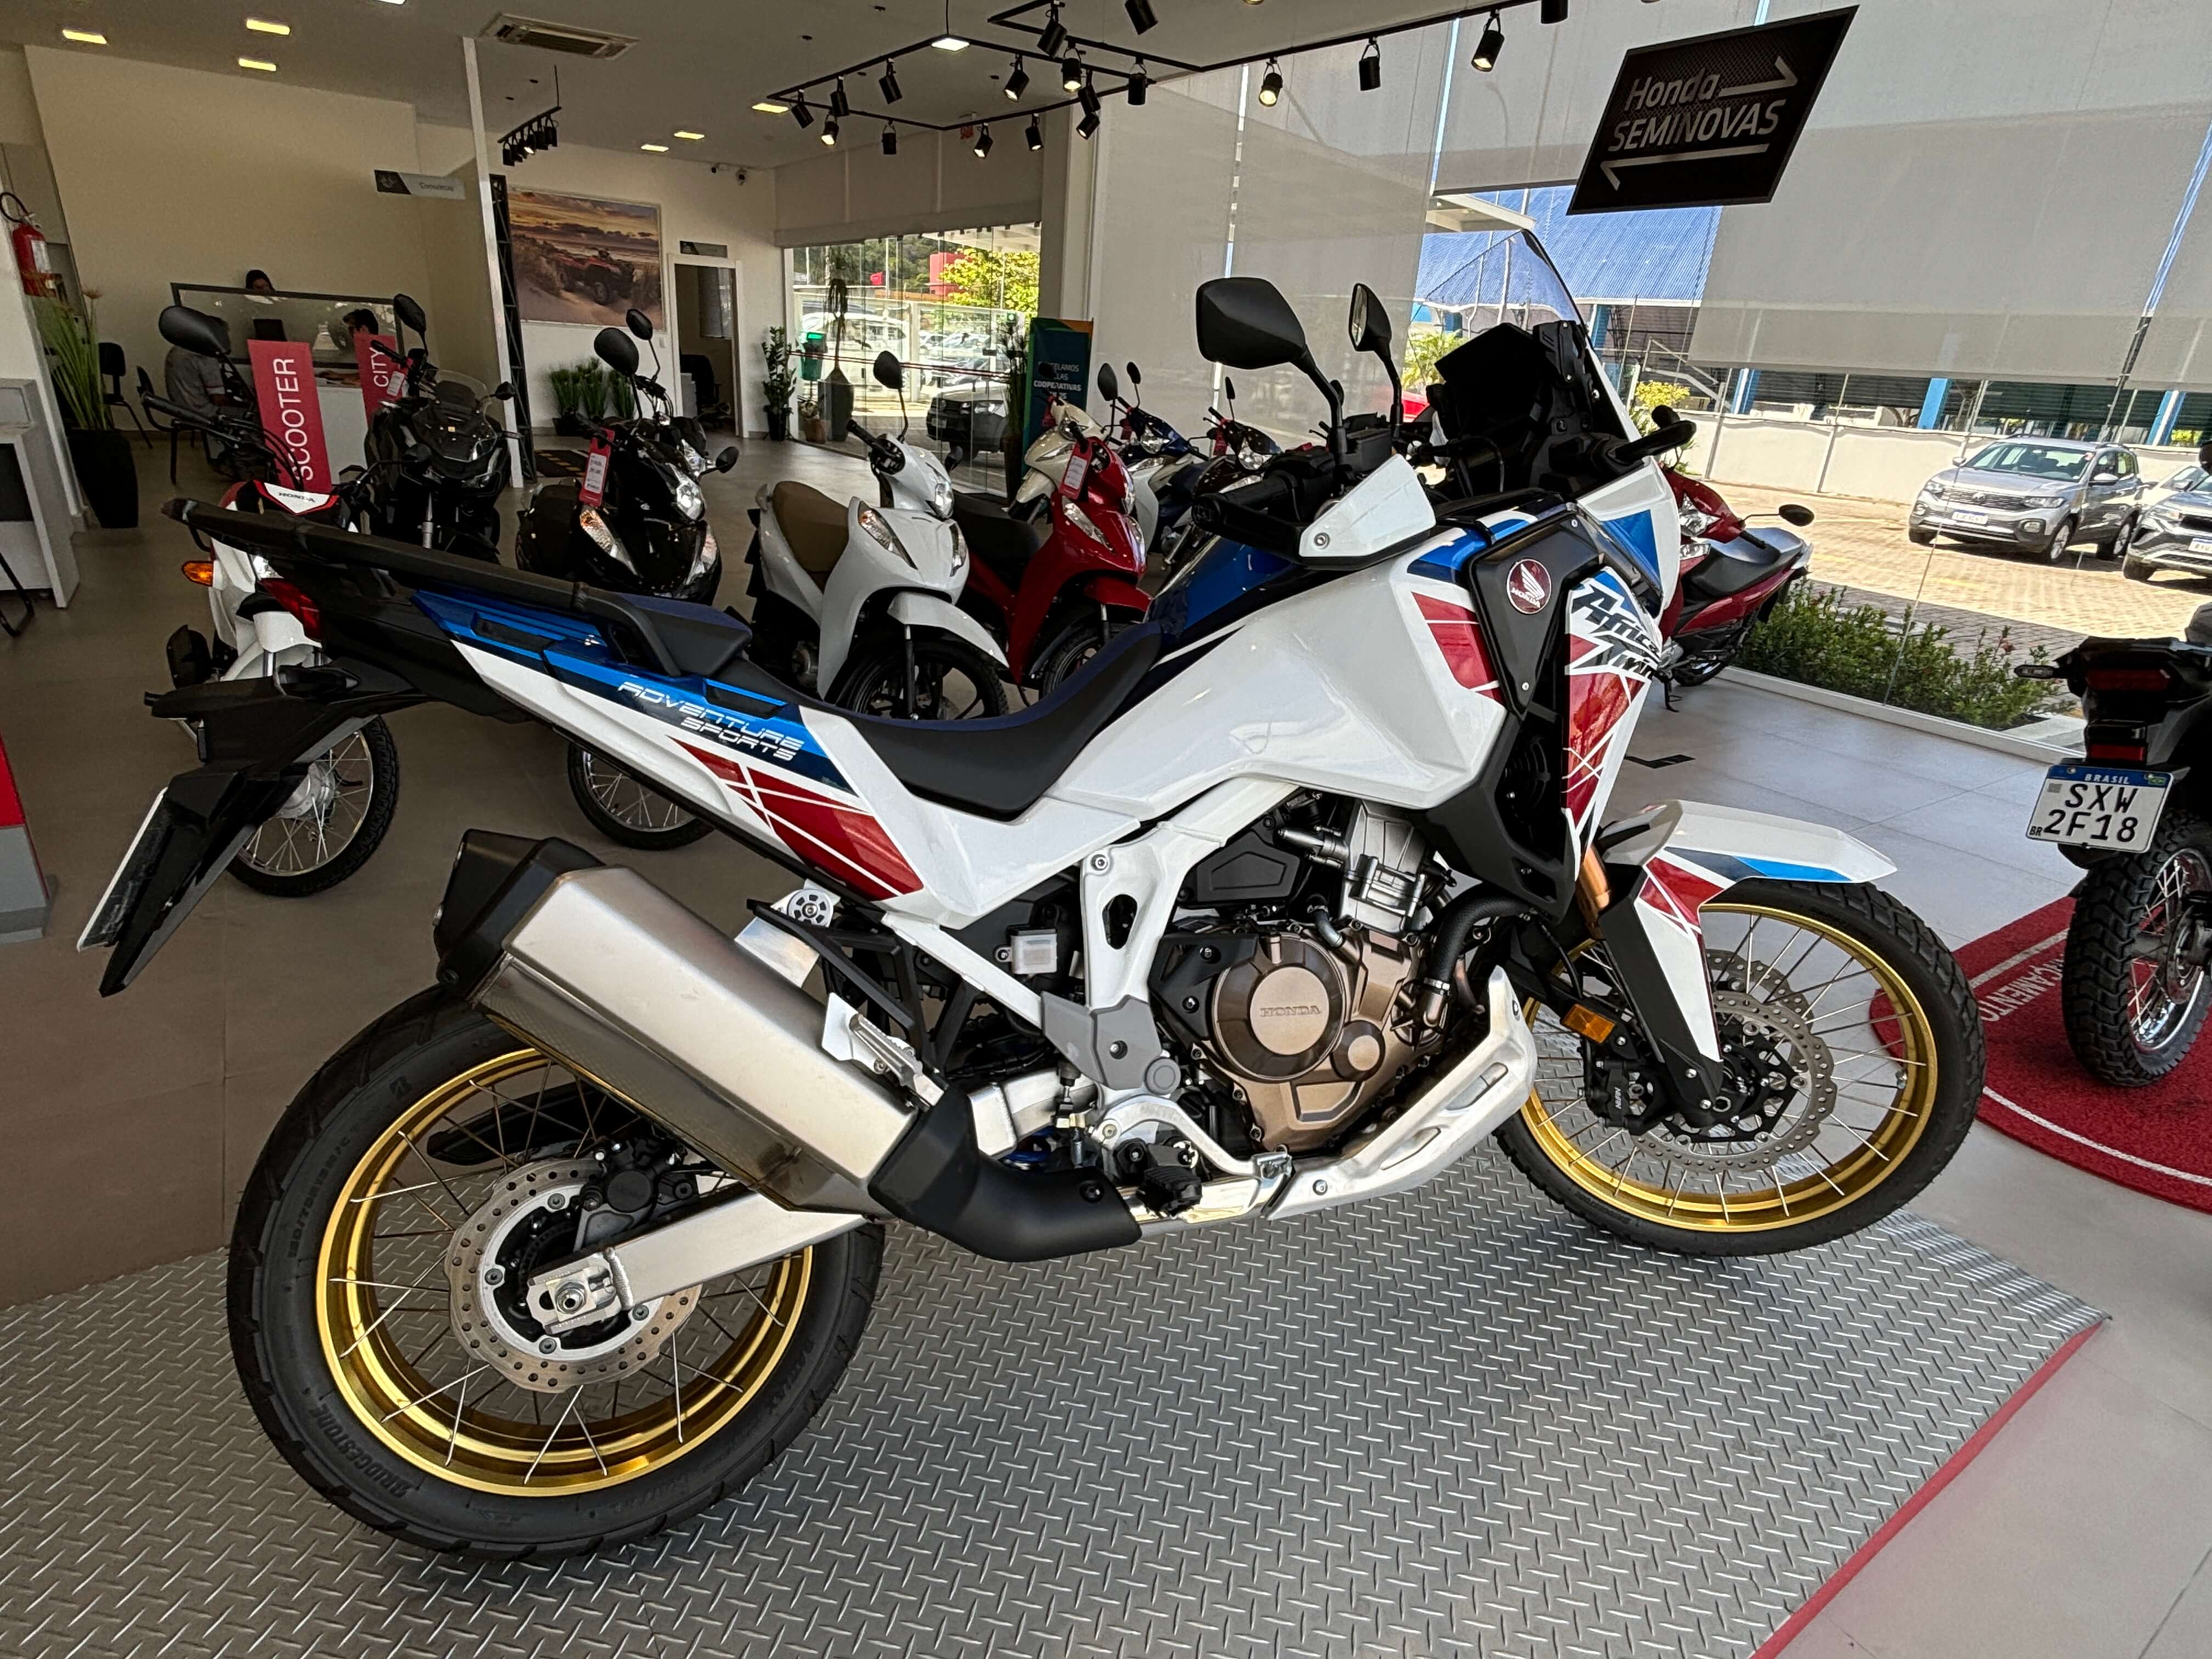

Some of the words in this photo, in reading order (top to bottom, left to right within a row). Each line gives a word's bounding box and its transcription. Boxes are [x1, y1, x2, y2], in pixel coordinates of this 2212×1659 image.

[1624, 68, 1721, 111] Honda
[1608, 99, 1786, 152] SEMINOVAS
[369, 347, 389, 387] CITY
[273, 358, 314, 481] SCOOTER
[278, 493, 316, 503] HONDA
[1511, 587, 1541, 608] HONDA
[618, 682, 805, 751] ADVENTURE
[680, 716, 797, 761] SPORTS
[2085, 774, 2130, 784] BRASIL
[2065, 783, 2138, 813] SXW
[2029, 826, 2042, 837] BR
[2043, 809, 2138, 842] 2F18
[1260, 1005, 1322, 1018] HONDA
[309, 1403, 414, 1498] BRIDGESTONE
